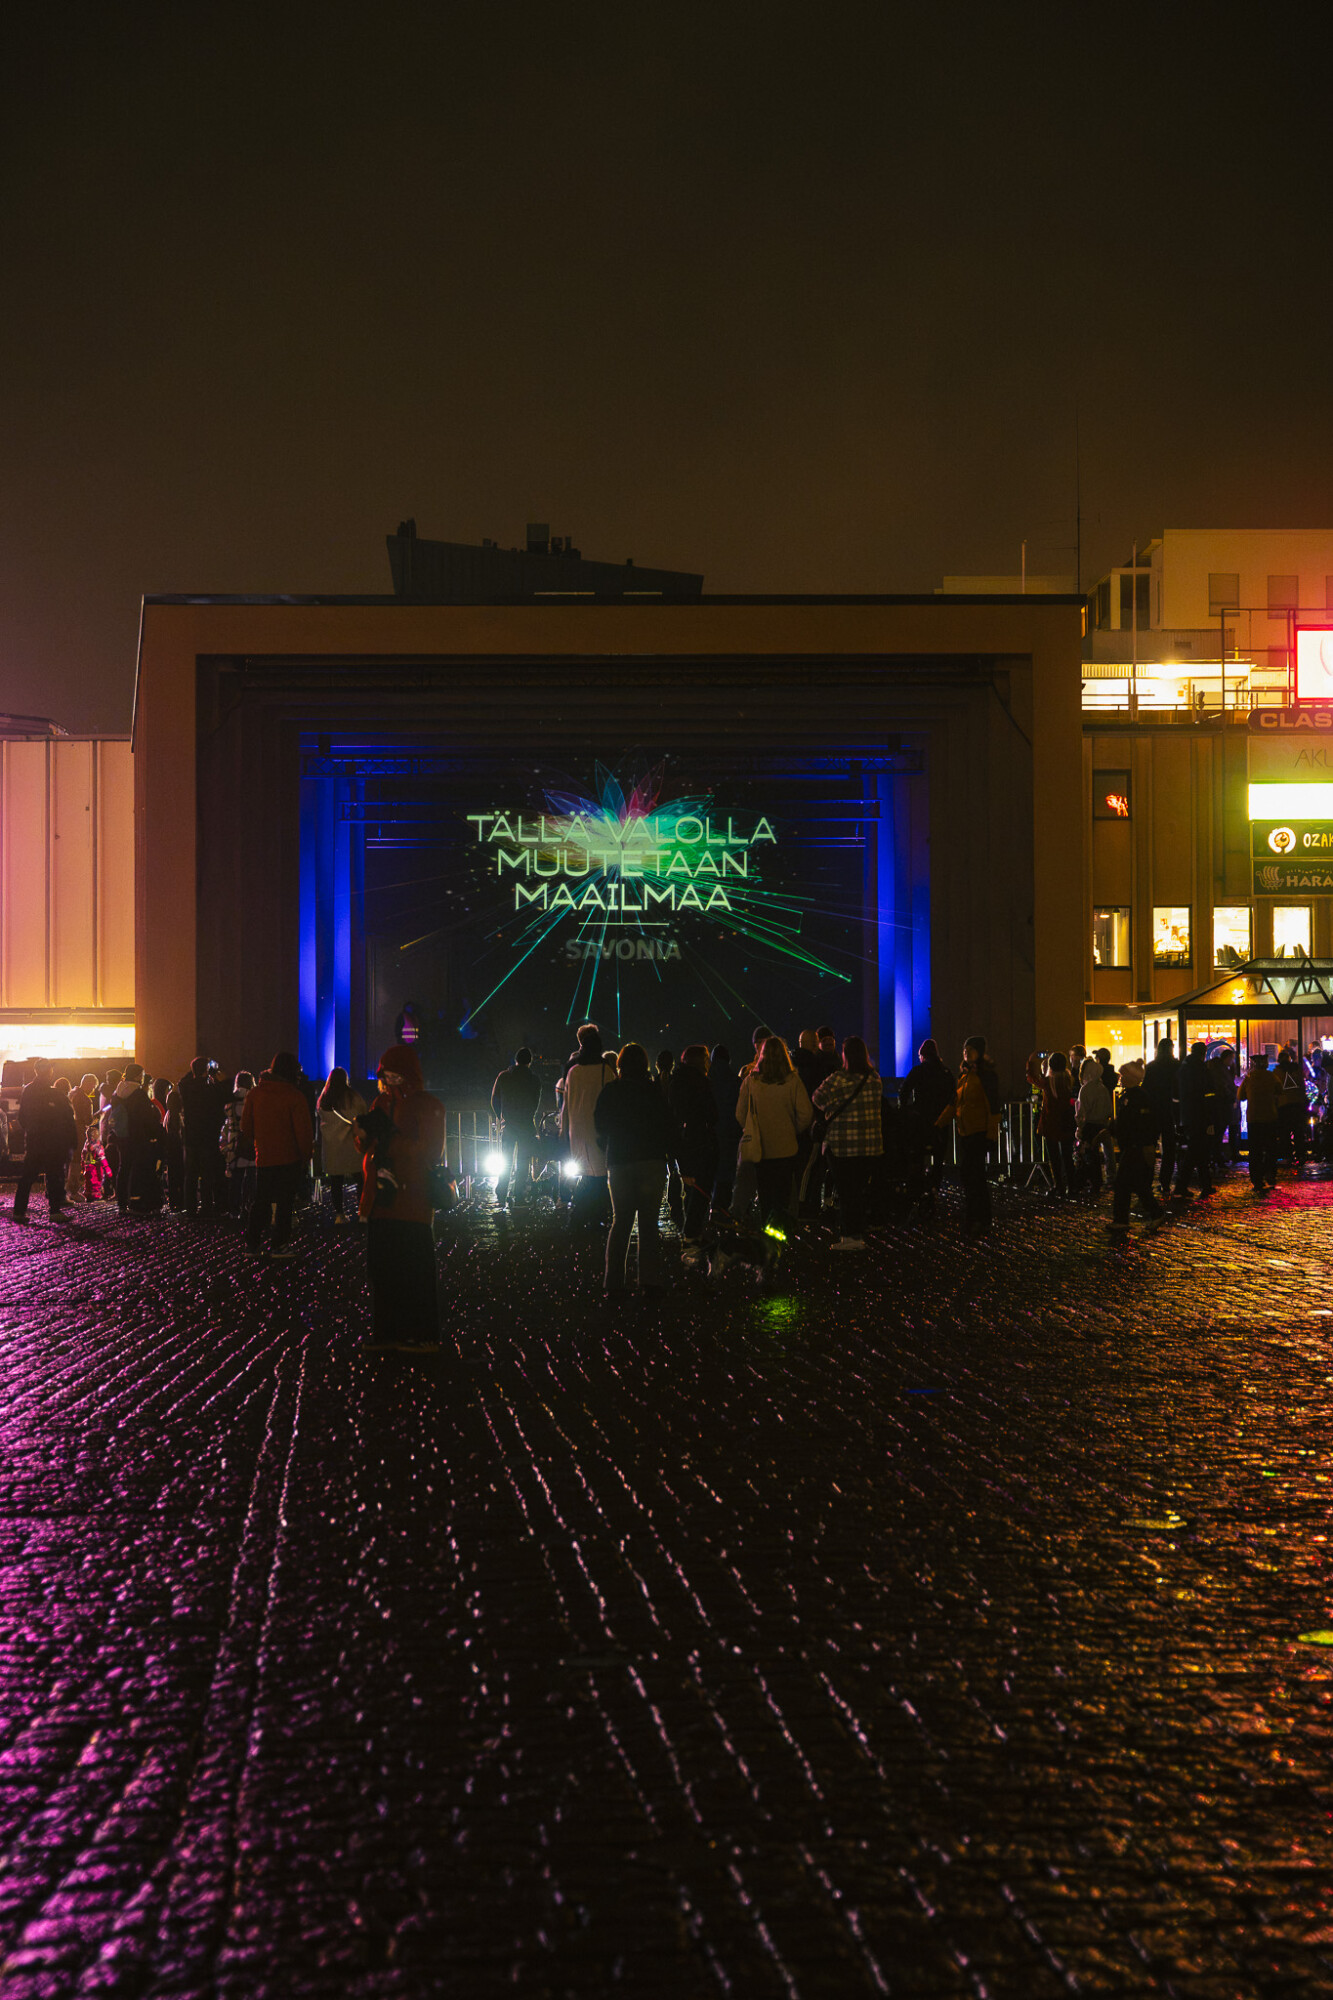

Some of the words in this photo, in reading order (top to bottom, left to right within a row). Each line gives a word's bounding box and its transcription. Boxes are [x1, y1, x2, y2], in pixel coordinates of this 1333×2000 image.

[466, 810, 592, 843] TÄLLÄ
[604, 815, 778, 844] VALOLLA
[498, 849, 748, 878] MUUTETAAN
[515, 882, 732, 911] MAAILMAA
[565, 938, 682, 960] SAVONIA
